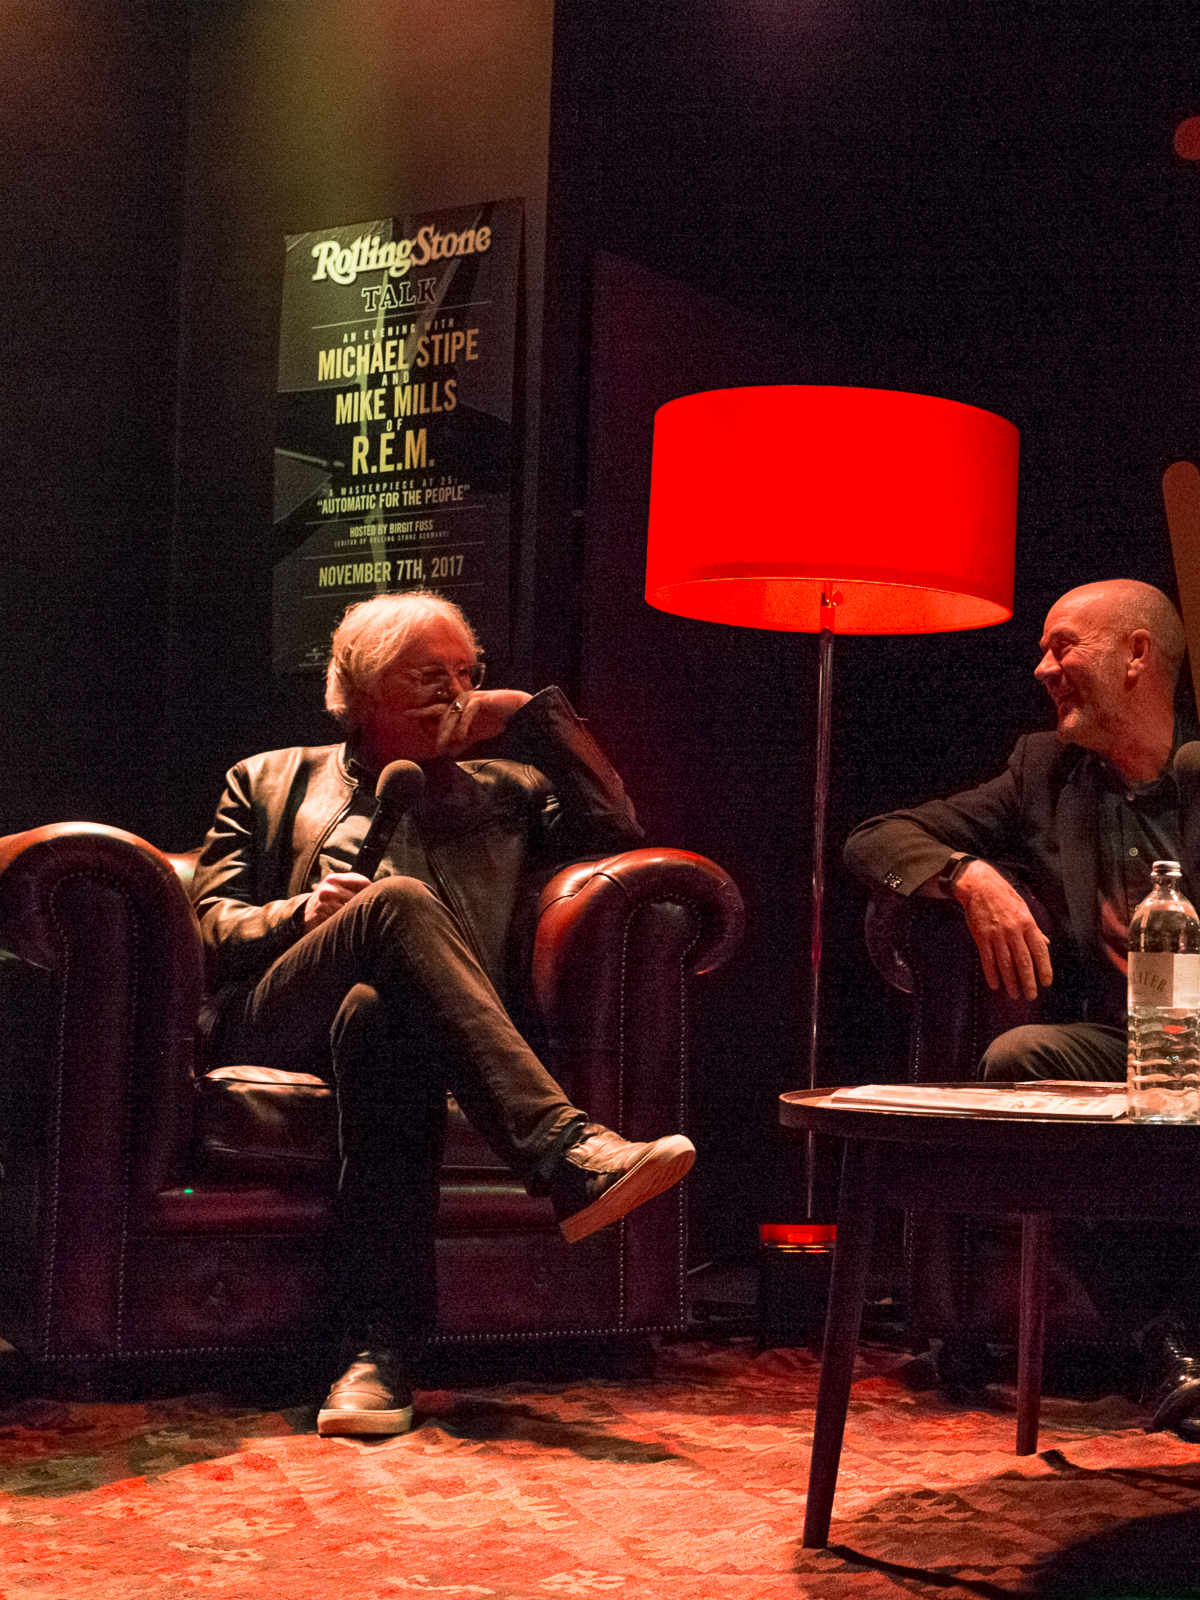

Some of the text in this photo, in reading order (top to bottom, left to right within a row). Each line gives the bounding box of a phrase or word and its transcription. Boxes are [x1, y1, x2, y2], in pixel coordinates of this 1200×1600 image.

[361, 278, 437, 312] TALK
[343, 318, 455, 344] AN EVENING WITH
[318, 328, 480, 381] MICHAEL STIPE
[381, 371, 410, 387] AND
[335, 379, 457, 425] MIKE MILLS
[386, 418, 403, 432] OF
[352, 428, 435, 475] R.E.M.
[341, 480, 414, 496] MASTERPIECE
[379, 491, 399, 509] FOR
[403, 489, 422, 506] THE
[350, 519, 434, 538] HOSTED BY BIRGIT FUSS
[319, 555, 464, 588] NOVEMBER 7TH, 2017
